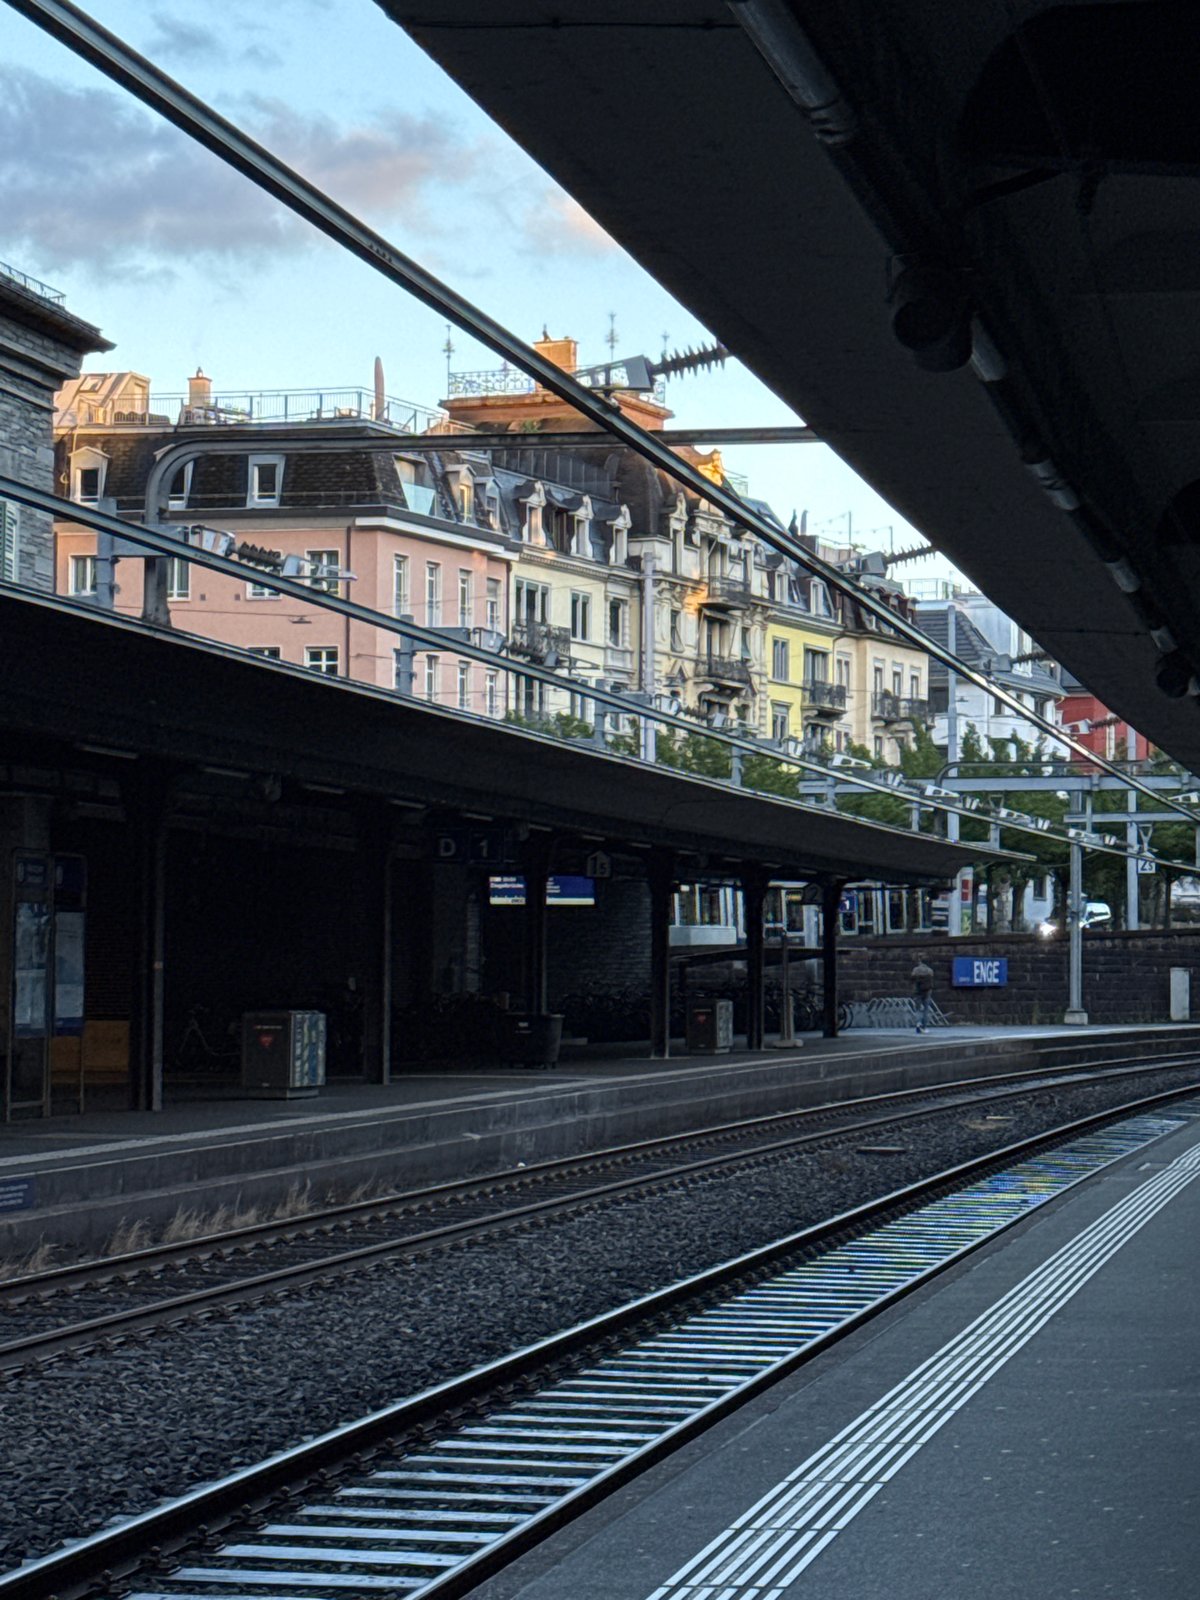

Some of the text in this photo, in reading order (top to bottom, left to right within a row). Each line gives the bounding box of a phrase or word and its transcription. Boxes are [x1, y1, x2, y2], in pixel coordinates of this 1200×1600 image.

[439, 837, 489, 858] D 1
[973, 960, 1000, 984] ENGE
